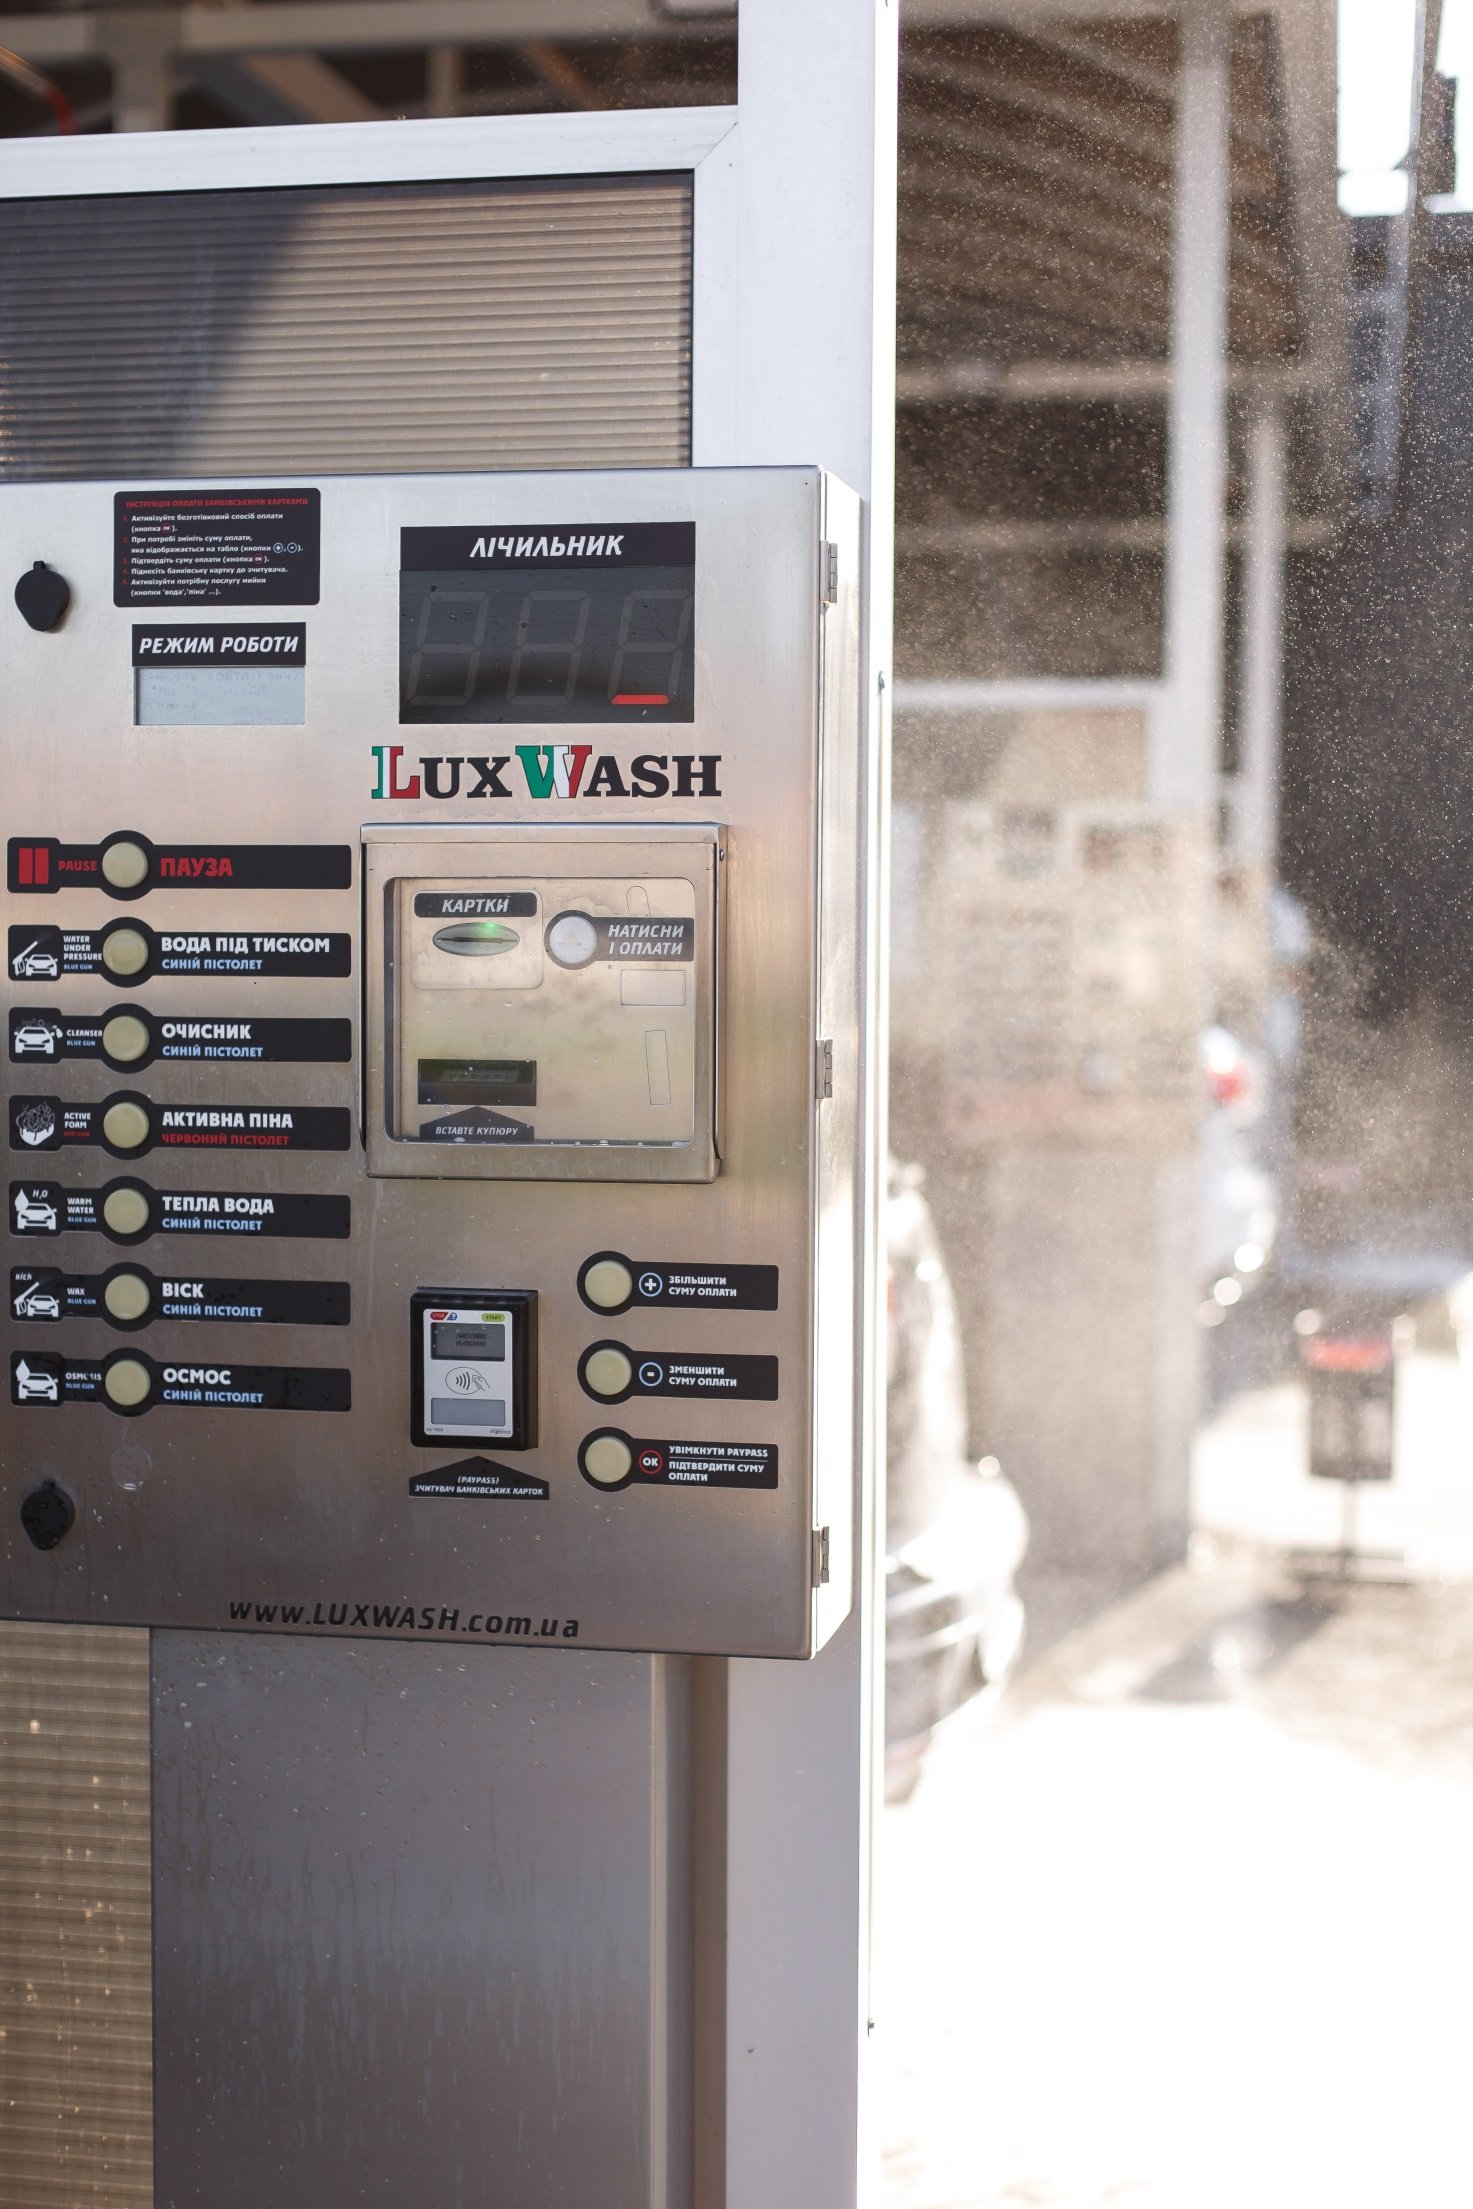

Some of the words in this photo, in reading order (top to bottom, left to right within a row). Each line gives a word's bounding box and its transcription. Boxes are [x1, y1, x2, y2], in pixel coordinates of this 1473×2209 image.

[131, 514, 175, 522] Активізуйте
[177, 513, 229, 521] безготівковий
[131, 525, 161, 534] (кнопка
[131, 536, 145, 544] При
[147, 535, 176, 543] потребі
[146, 545, 204, 553] відображається
[240, 544, 271, 553] (кнопки
[469, 535, 625, 558] ЛІЧИЛЬНИК
[131, 556, 174, 564] Підтвердіть
[222, 555, 253, 564] (кнопка
[131, 567, 165, 576] Піднесіть
[167, 567, 208, 575] банківську
[210, 567, 235, 575] картку
[248, 566, 288, 574] зчитувача.
[177, 577, 209, 585] потрібну
[131, 588, 161, 596] (кнопки
[139, 637, 214, 654] РЕЖИМ
[220, 636, 299, 653] РОБОТИ
[58, 860, 97, 871] PAUSE
[160, 858, 233, 877] ПАУЗА
[442, 899, 509, 913] КАРТКИ
[608, 924, 684, 939] НАТИСНИ
[63, 935, 90, 943] WATER
[161, 936, 212, 954] ВОДА
[216, 936, 249, 954] ПІД
[253, 937, 330, 953] ТИСКОМ
[619, 941, 682, 956] ОПЛАТИ
[162, 956, 201, 970] СИНІЙ
[203, 958, 263, 970] ПІСТОЛЕТ
[66, 1029, 103, 1037] CLEANSER
[161, 1023, 251, 1040] ОЧИСНИК
[162, 1043, 201, 1057] СИНІЙ
[204, 1046, 264, 1058] ПІСТОЛЕТ
[64, 1112, 91, 1120] ACTIVE
[162, 1111, 245, 1128] АКТИВНА
[249, 1112, 293, 1129] ПІНА
[435, 1126, 474, 1136] ВСТАВТЕ
[476, 1126, 519, 1136] КУПЮРУ
[162, 1132, 227, 1145] ЧЕРВОНИЙ
[230, 1134, 290, 1146] ПІСТОЛЕТ
[67, 1206, 94, 1214] WATER
[162, 1195, 220, 1212] ТЕПЛА
[224, 1197, 274, 1215] ВОДА
[162, 1217, 201, 1230] СИНІЙ
[203, 1219, 263, 1231] ПІСТОЛЕТ
[669, 1276, 727, 1285] ЗБІЛЬШИТИ
[67, 1288, 85, 1296] WAX
[162, 1282, 204, 1299] ВІСК
[668, 1287, 696, 1296] СУМУ
[697, 1288, 737, 1297] ОПЛАТИ
[162, 1303, 201, 1316] СИНІЙ
[204, 1305, 263, 1318] ПІСТОЛЕТ
[669, 1366, 725, 1375] ЗМЕНШИТИ
[163, 1368, 231, 1385] ОСМОС
[669, 1377, 696, 1386] СУМУ
[697, 1378, 737, 1387] ОПЛАТИ
[163, 1389, 202, 1402] СИНІЙ
[204, 1391, 264, 1404] ПІСТОЛЕТ
[669, 1446, 725, 1455] УВІМКНУТИ
[727, 1448, 768, 1457] PAYPASS
[642, 1457, 659, 1466] OK
[669, 1462, 735, 1472] ПІДТВЕРДИТИ
[737, 1464, 764, 1473] СУМУ
[458, 1476, 499, 1484] (PAYPASS)
[669, 1473, 708, 1481] ОПЛАТИ
[456, 1486, 511, 1494] БАНКІВСЬКИХ
[228, 1601, 580, 1638] www.LUXWASH.com.ua
